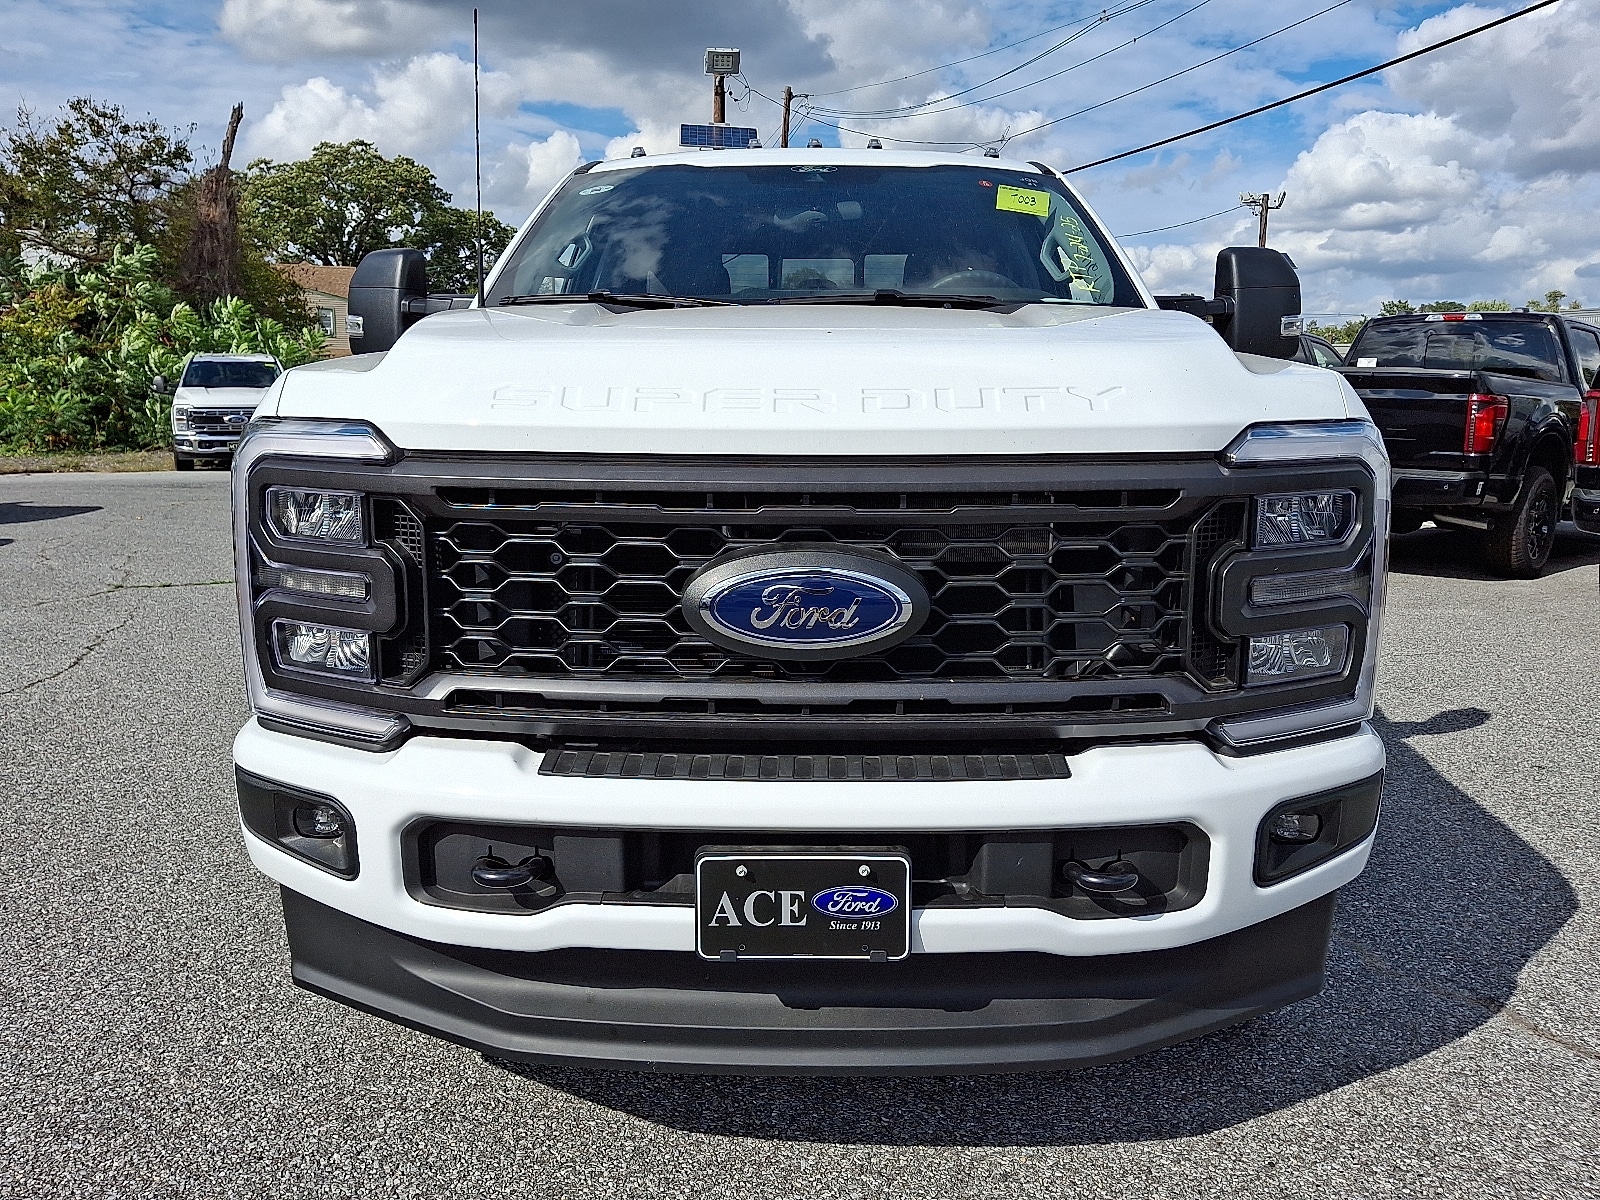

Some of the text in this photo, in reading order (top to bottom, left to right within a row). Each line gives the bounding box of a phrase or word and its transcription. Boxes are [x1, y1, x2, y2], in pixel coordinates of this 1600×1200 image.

[1010, 193, 1037, 206] T003
[491, 384, 1127, 413] SUPER DUTY
[751, 584, 863, 630] Ford
[708, 890, 808, 927] ACE
[827, 891, 882, 913] Ford
[829, 920, 881, 931] Since 1913
